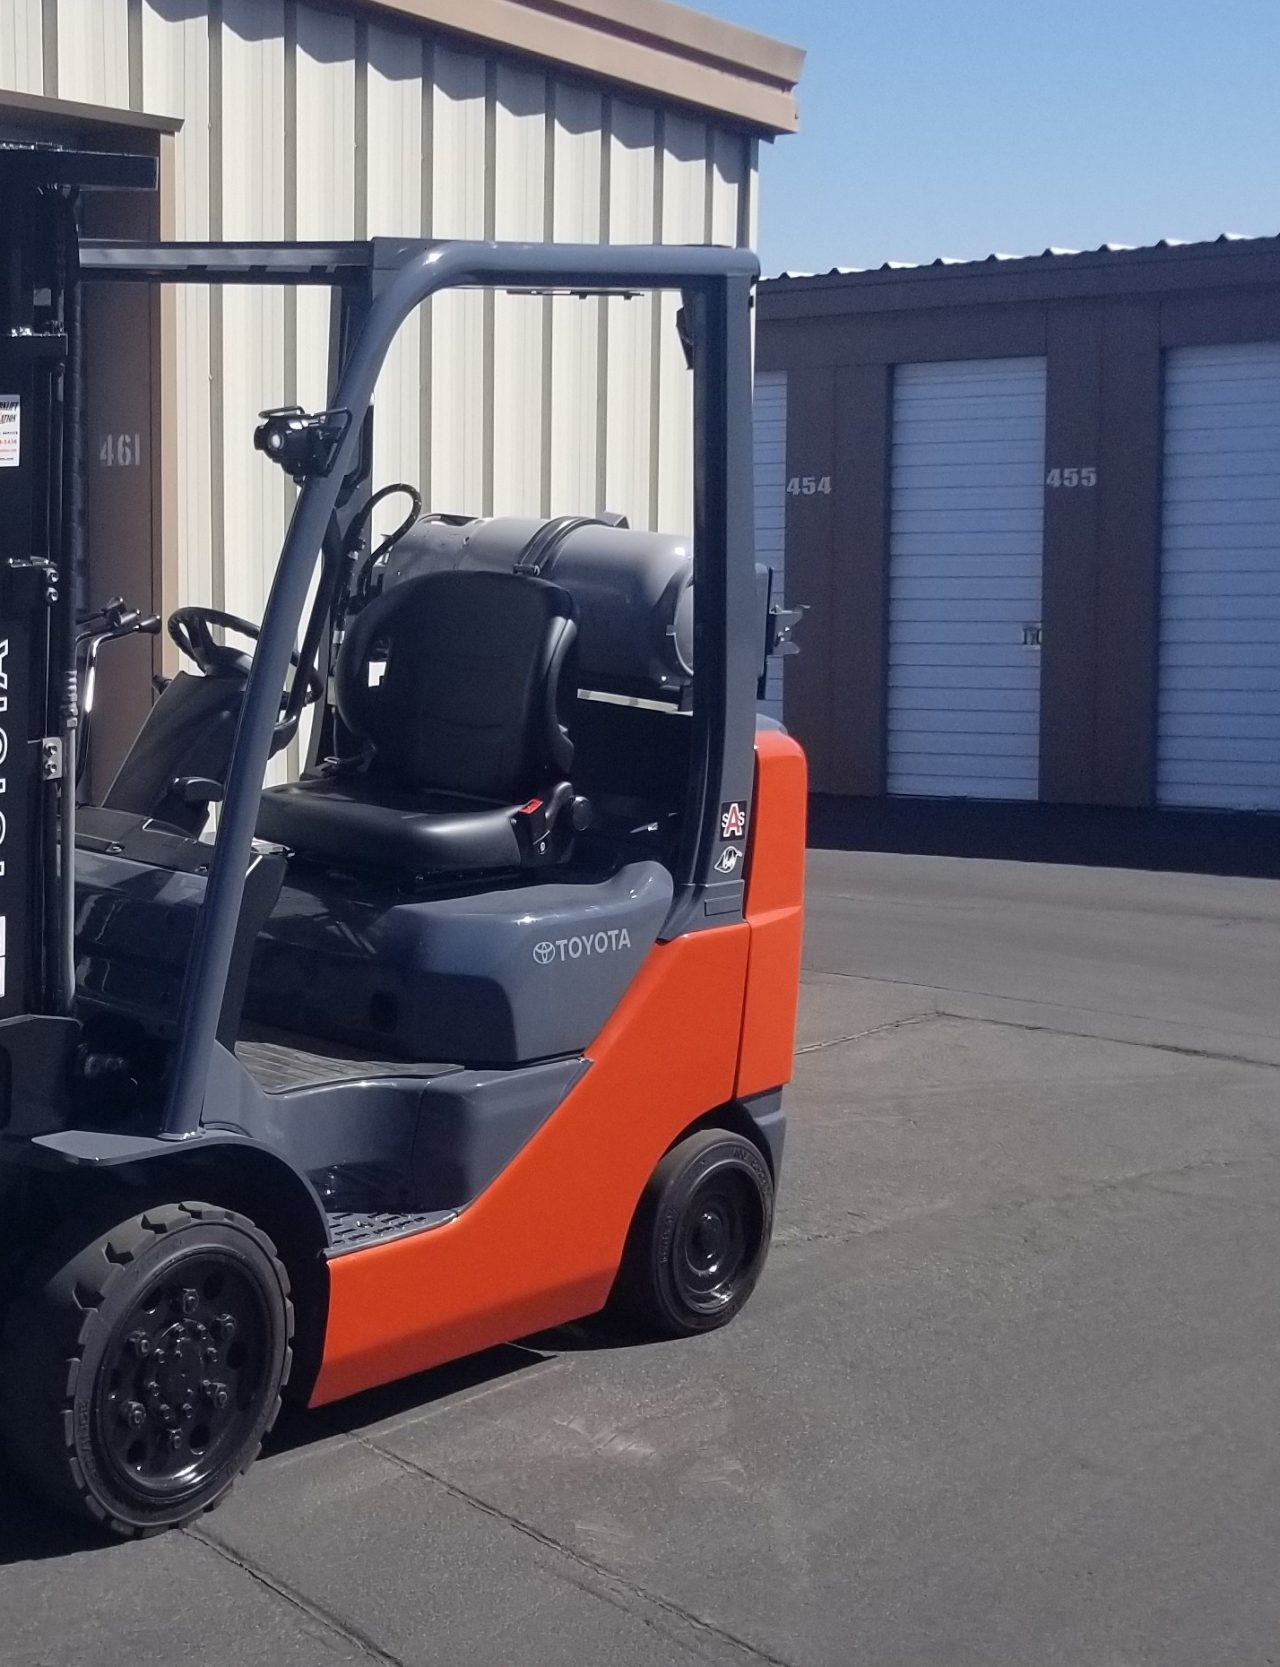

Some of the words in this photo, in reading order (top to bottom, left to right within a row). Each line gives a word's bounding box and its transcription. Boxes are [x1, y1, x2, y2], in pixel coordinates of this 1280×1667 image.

[99, 433, 140, 466] 461
[786, 476, 832, 495] 454
[1046, 467, 1097, 488] 455
[555, 928, 631, 961] TOYOTA
